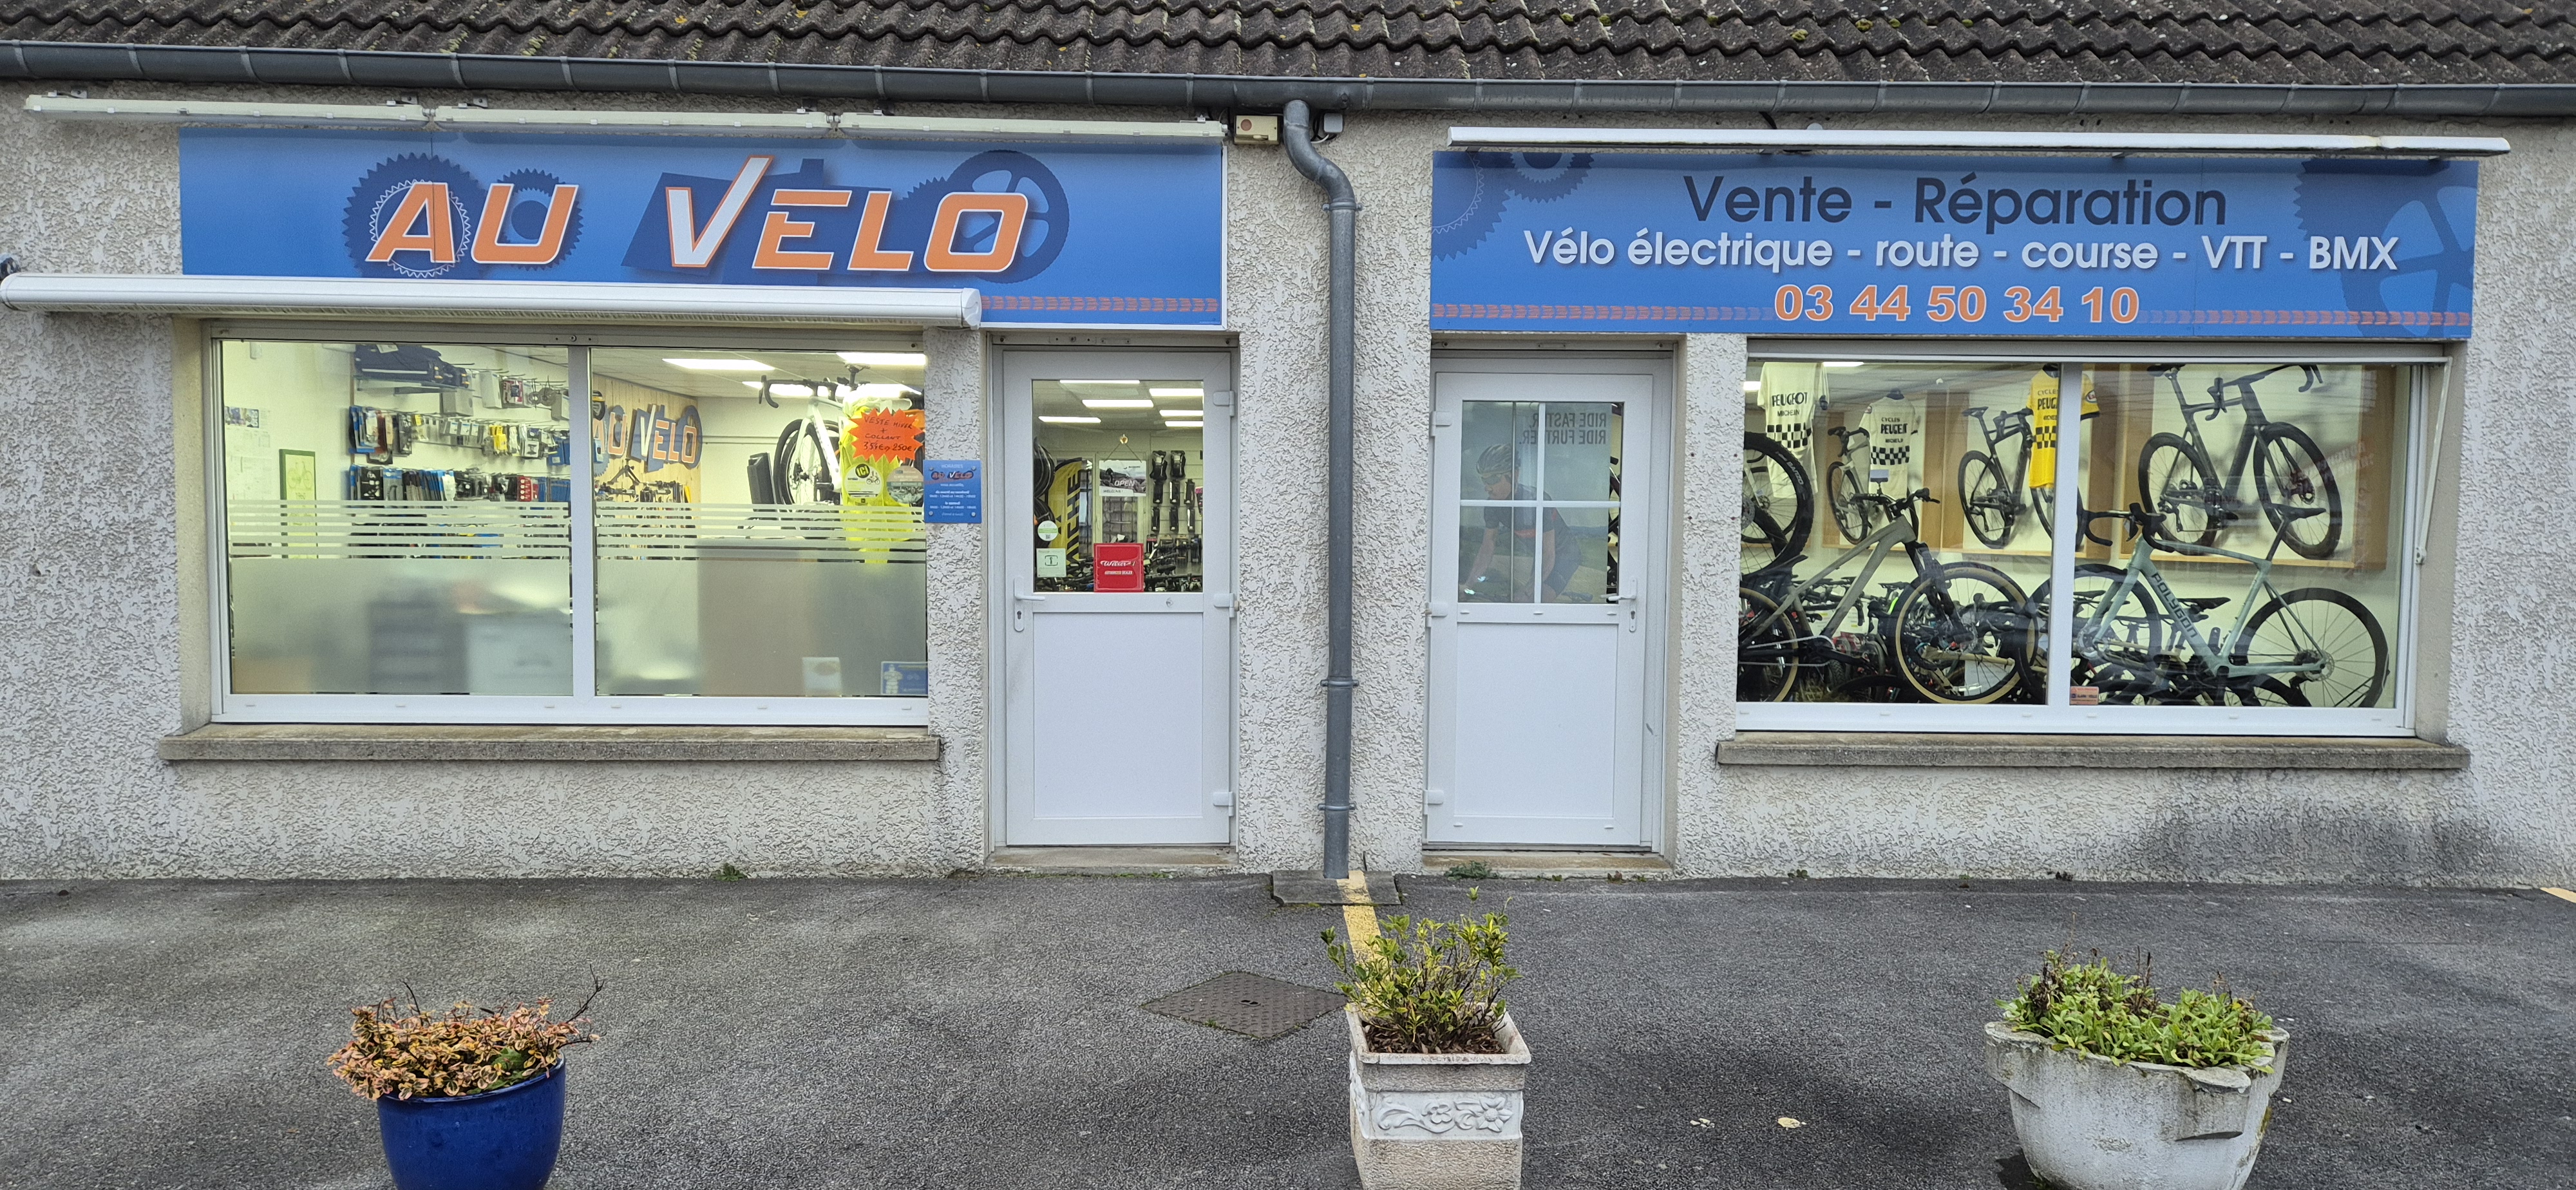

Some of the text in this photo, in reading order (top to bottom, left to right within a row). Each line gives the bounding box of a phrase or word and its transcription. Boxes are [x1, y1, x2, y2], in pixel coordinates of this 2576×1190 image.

[365, 154, 1030, 274] AU VELO
[1683, 172, 2227, 234] Vente - Réparation
[1523, 227, 1615, 266] Vélo
[1627, 227, 1833, 273] électrique
[1875, 233, 1980, 269] route
[1993, 250, 2008, 259] -
[2022, 239, 2159, 270] course
[2201, 234, 2268, 269] VTT
[2280, 252, 2295, 261] -
[2308, 236, 2400, 270] BMX
[1774, 283, 2140, 324] 03 44 50 34 10
[1772, 392, 1808, 407] PEUGEOT
[2037, 397, 2058, 410] PEUG
[864, 416, 890, 426] VESTE
[856, 466, 869, 477] ICI
[2152, 572, 2198, 638] POLYGON
